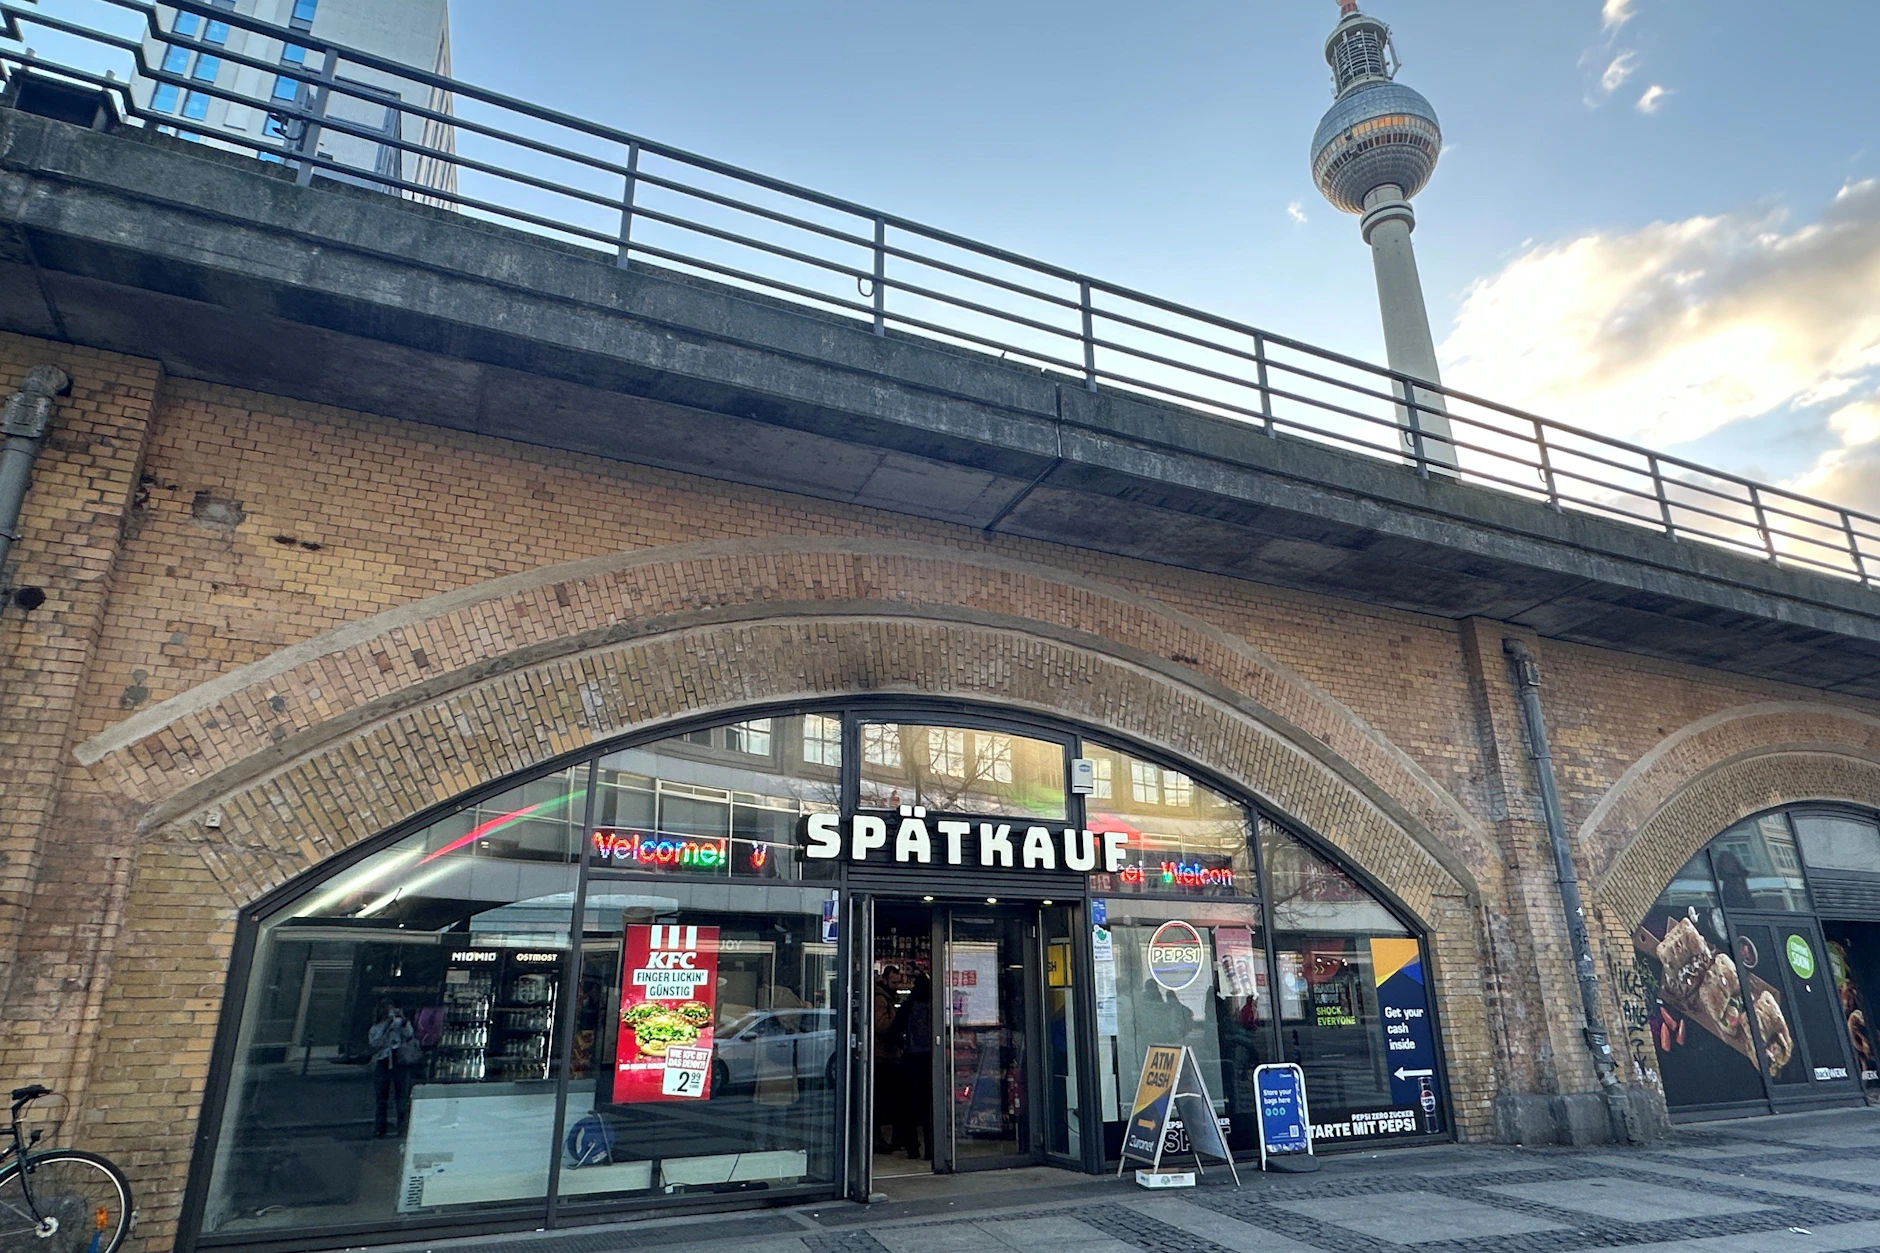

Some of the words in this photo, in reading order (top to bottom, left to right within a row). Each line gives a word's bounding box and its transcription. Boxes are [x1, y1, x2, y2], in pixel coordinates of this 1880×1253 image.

[806, 805, 1129, 872] SPÄTKAUF
[516, 953, 558, 962] OSTMOST
[646, 951, 697, 969] KFC
[1152, 947, 1200, 963] PEPSI
[637, 972, 670, 982] FINGER
[649, 984, 690, 996] GÜNSTIG
[1316, 1006, 1342, 1016] SHOCK
[1385, 1006, 1402, 1018] Get
[1403, 1009, 1424, 1020] your
[1317, 1016, 1356, 1026] EVERYONE
[1387, 1022, 1409, 1034] cash
[1389, 1038, 1416, 1050] inside
[1151, 1052, 1175, 1070] ATM
[1146, 1071, 1170, 1088] CASH
[1264, 1098, 1277, 1106] bags
[1352, 1113, 1371, 1121] PEPSI
[1389, 1110, 1414, 1118] ZUCKER
[1166, 1121, 1183, 1129] EPSI
[1308, 1122, 1351, 1139] TARTE
[1353, 1120, 1376, 1136] MIT
[1378, 1118, 1416, 1133] PEPSI
[1129, 1135, 1154, 1152] Euronet
